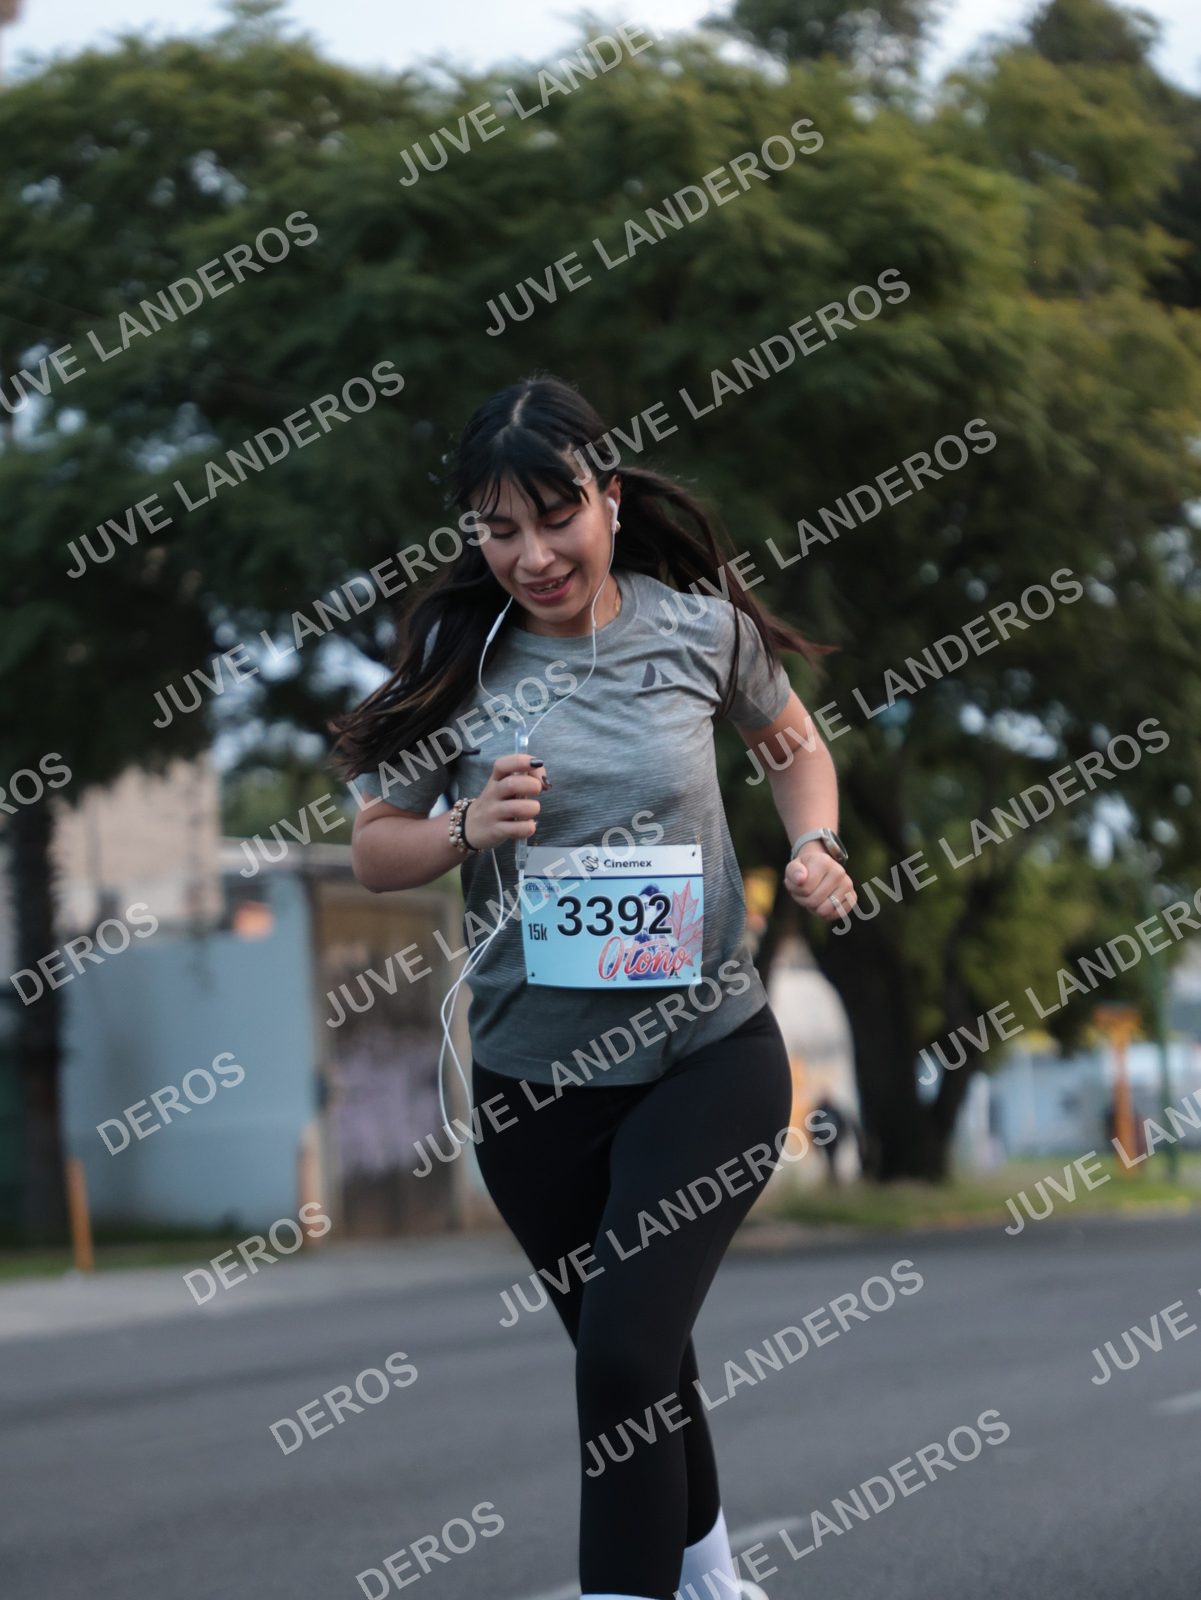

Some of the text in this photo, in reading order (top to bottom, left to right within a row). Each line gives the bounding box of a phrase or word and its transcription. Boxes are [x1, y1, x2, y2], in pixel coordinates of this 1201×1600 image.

[603, 858, 652, 868] Cinemex
[556, 895, 672, 937] 3392
[528, 922, 548, 941] 15k
